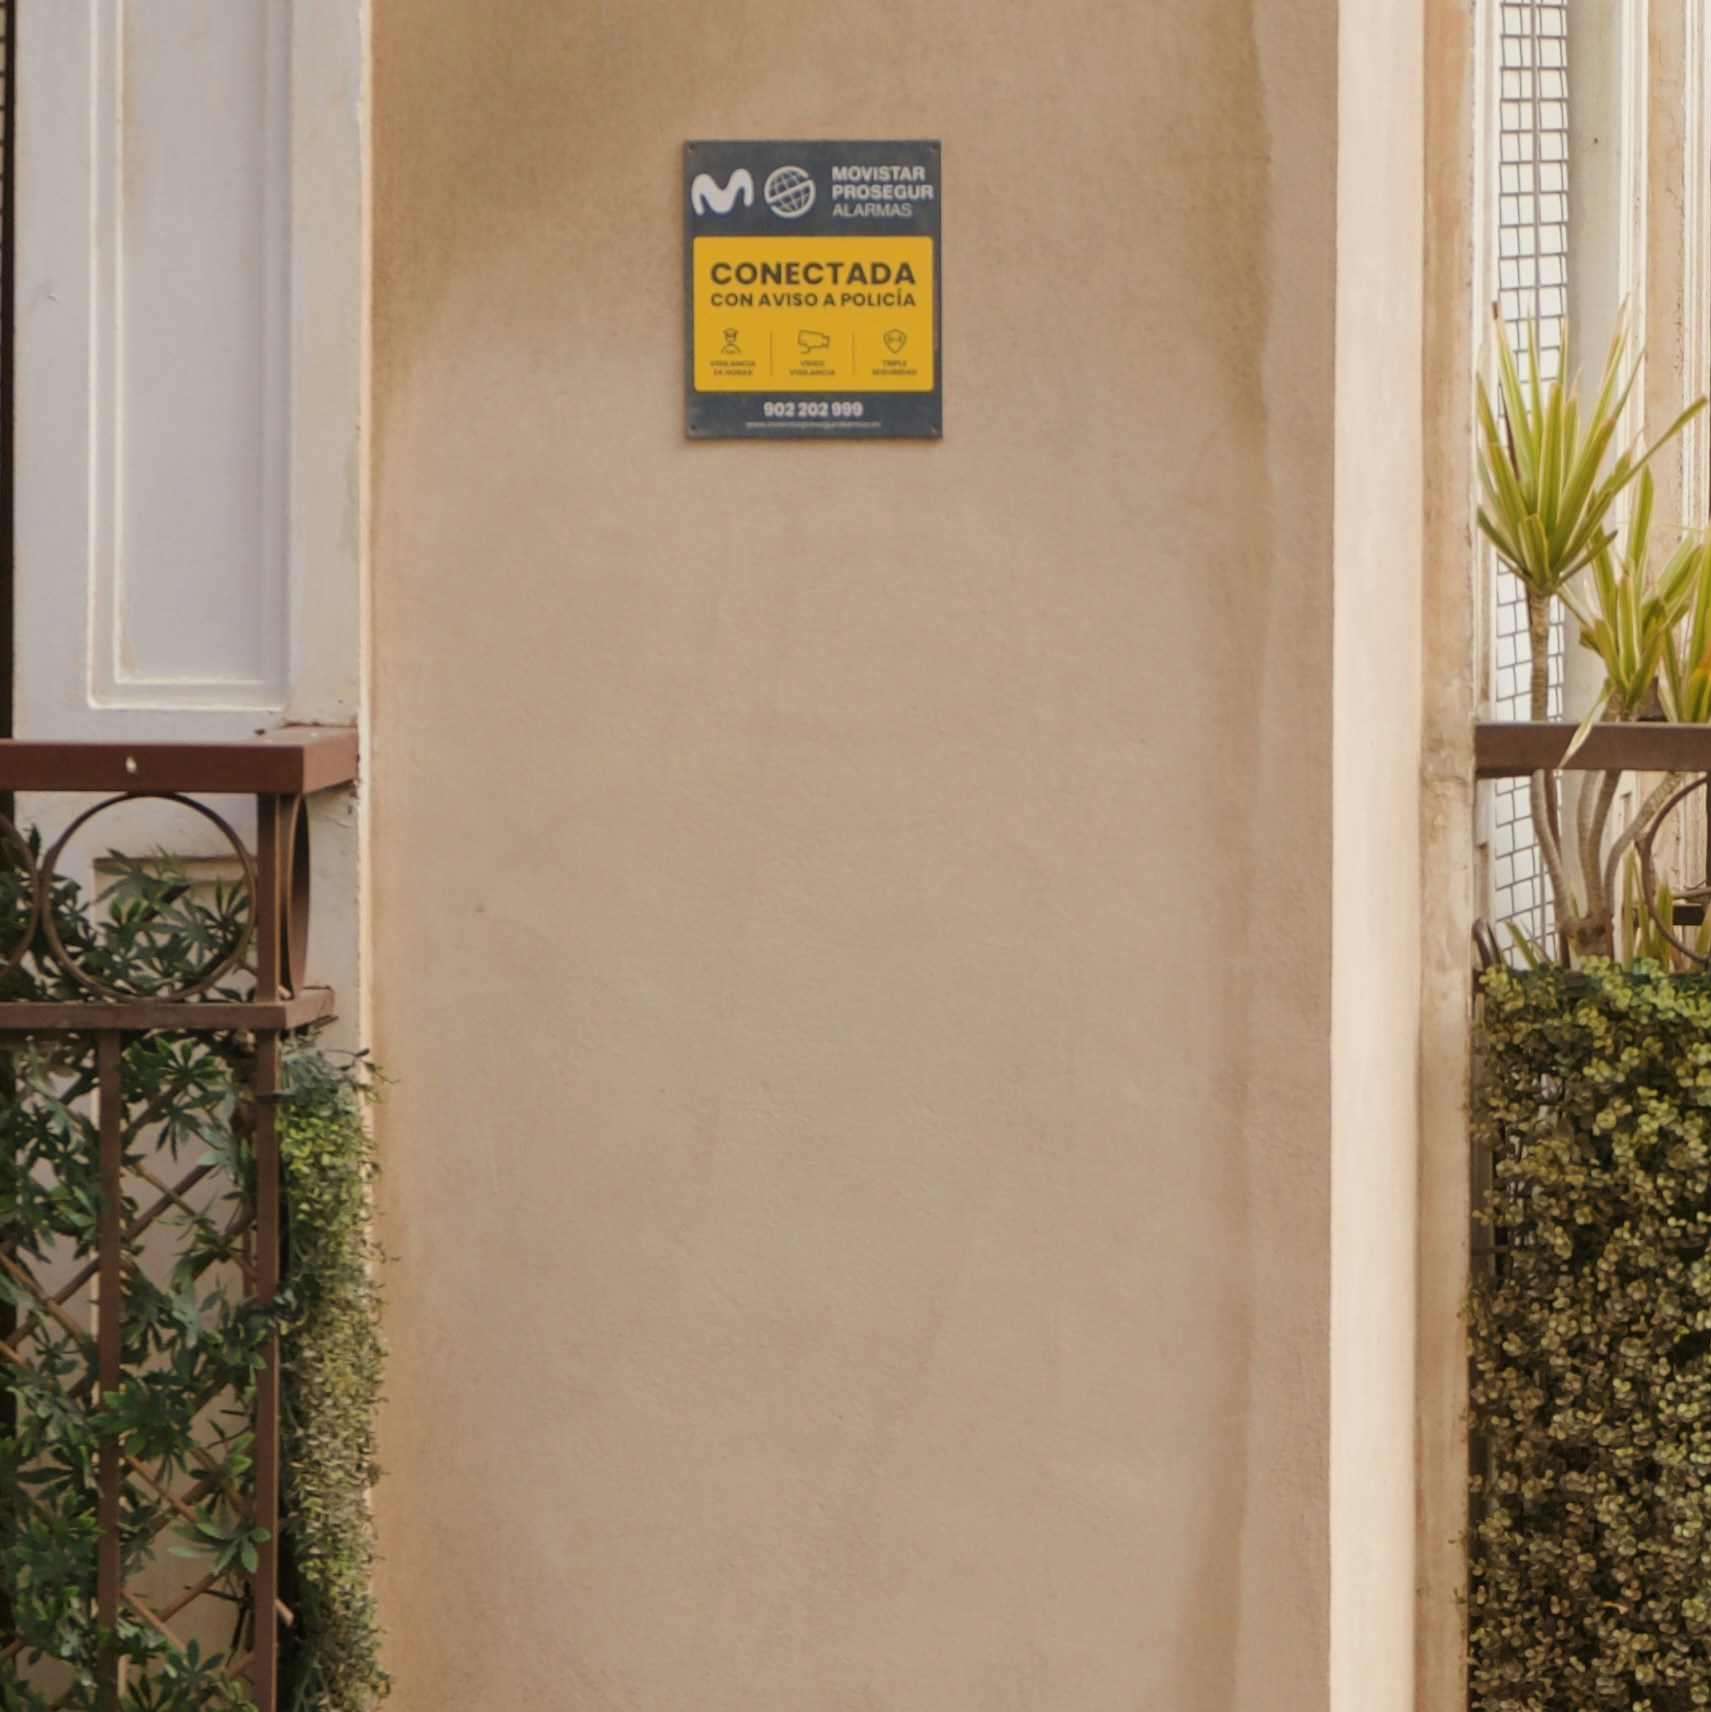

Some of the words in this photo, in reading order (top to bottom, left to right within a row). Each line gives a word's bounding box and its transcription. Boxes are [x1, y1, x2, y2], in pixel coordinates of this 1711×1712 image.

[831, 166, 926, 181] MOVISTAR
[831, 184, 934, 200] PROSEGUR
[832, 203, 912, 217] ALARMAS
[710, 262, 916, 286] CONECTADA
[711, 292, 754, 307] CON
[758, 292, 819, 307] AVISO
[823, 292, 836, 307] A
[841, 288, 916, 307] POLICÍA
[763, 401, 795, 418] 902
[797, 401, 829, 418] 202
[831, 401, 864, 418] 999
